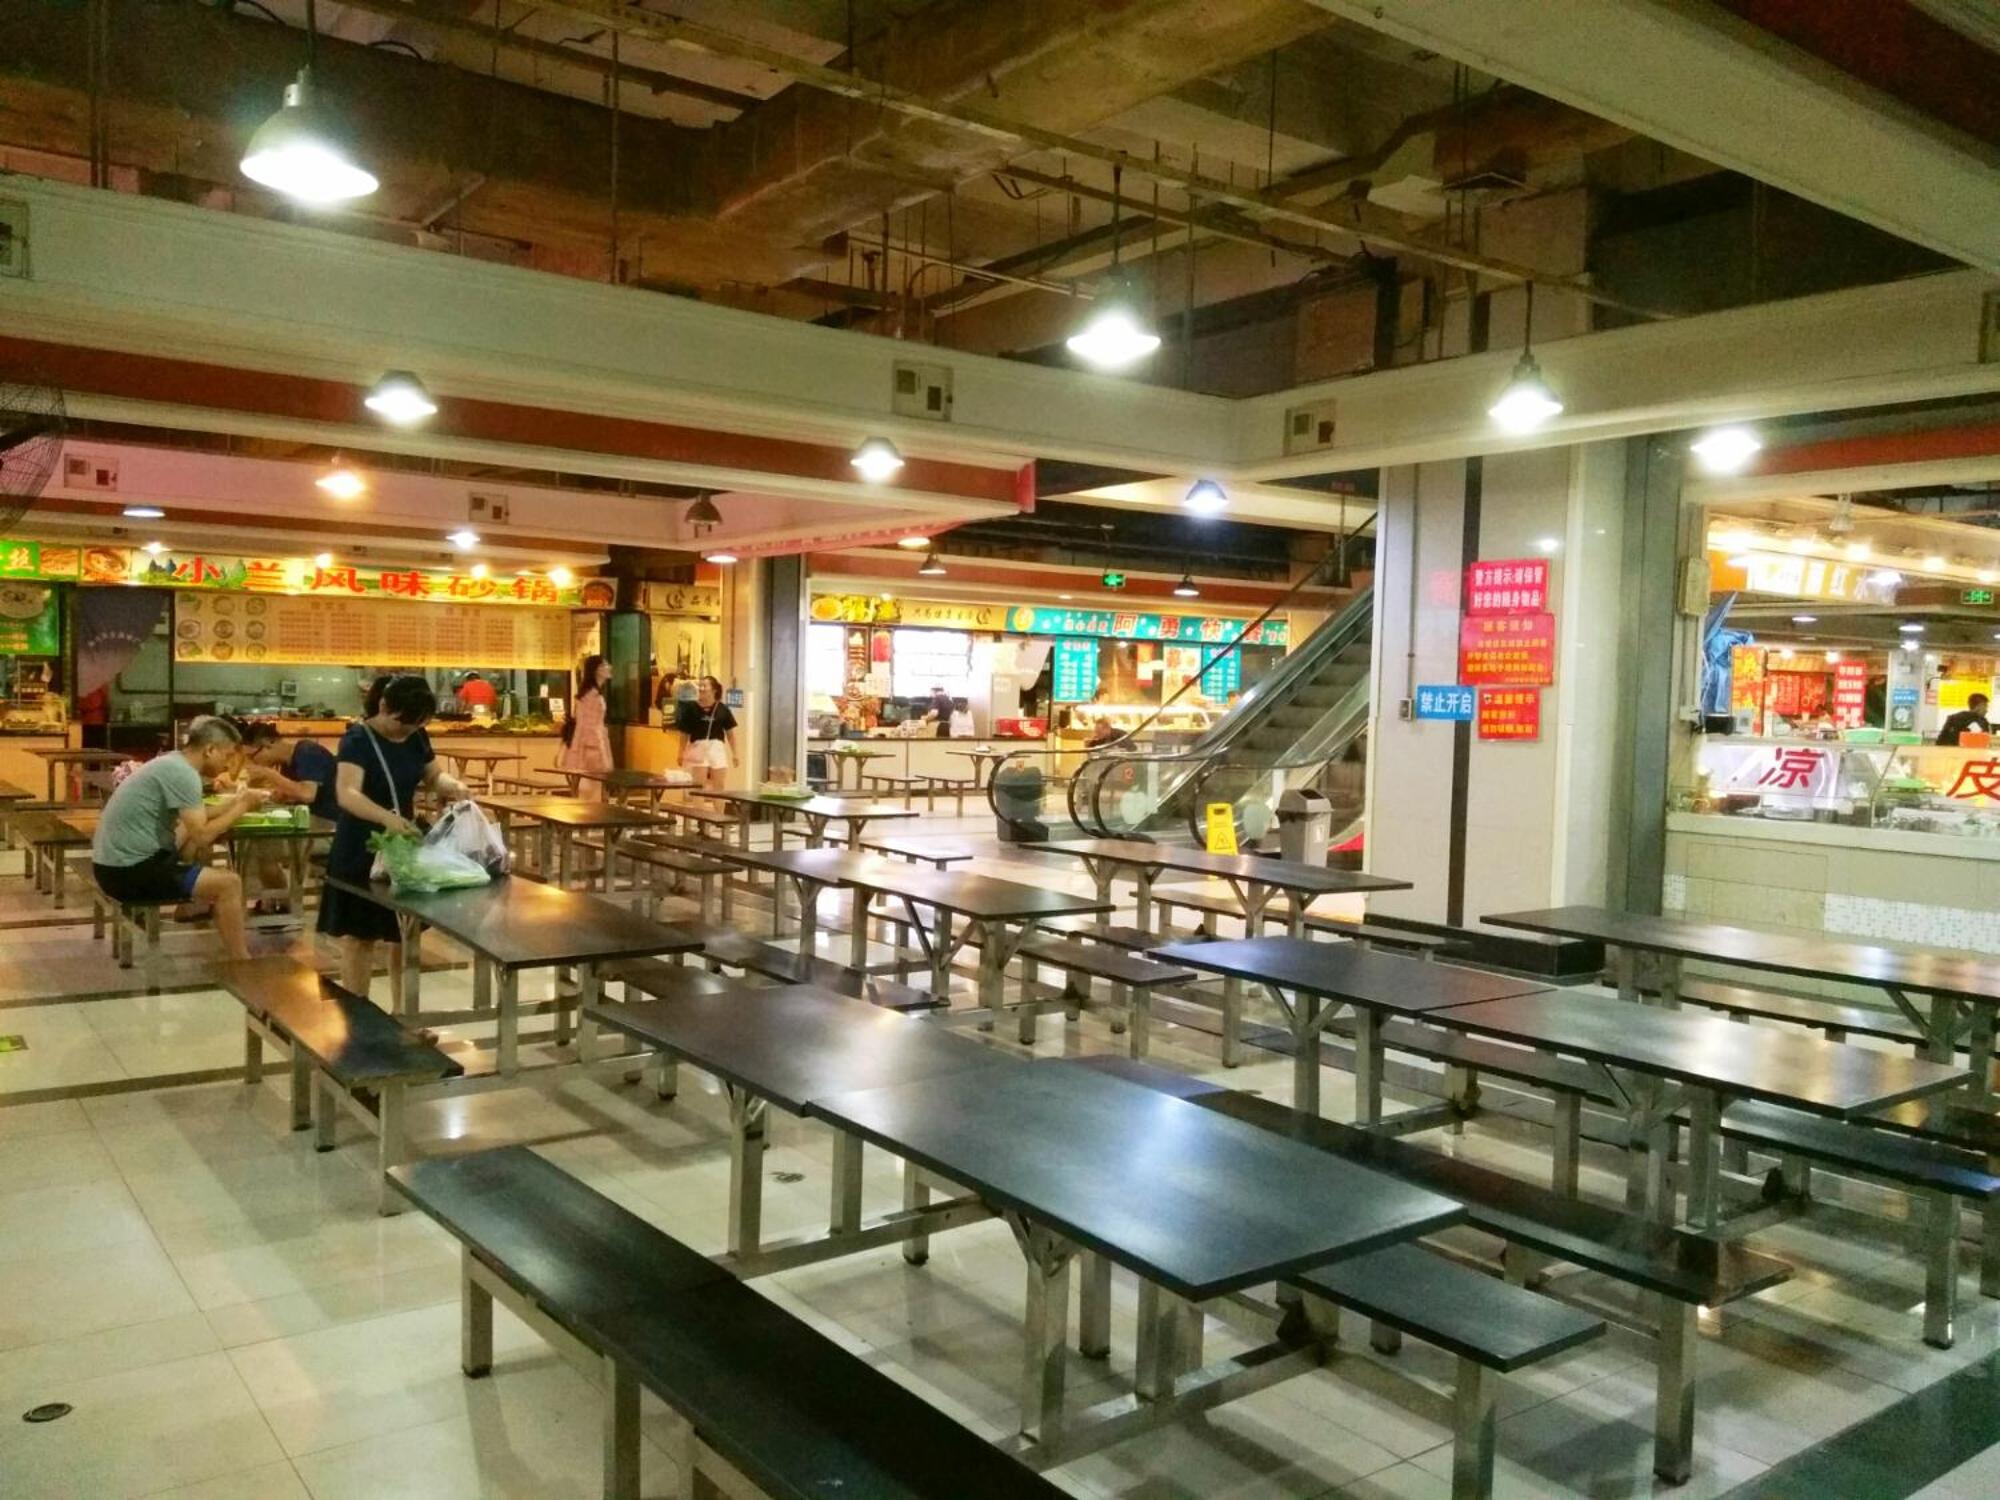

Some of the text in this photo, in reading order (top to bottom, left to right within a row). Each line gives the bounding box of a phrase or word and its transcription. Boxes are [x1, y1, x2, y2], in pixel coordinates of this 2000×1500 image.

[172, 555, 560, 602] 小兰风味砂锅
[1111, 611, 1264, 643] 阿勇快餐
[1420, 691, 1473, 714] 禁止开启
[1758, 747, 2000, 801] 凉 皮
